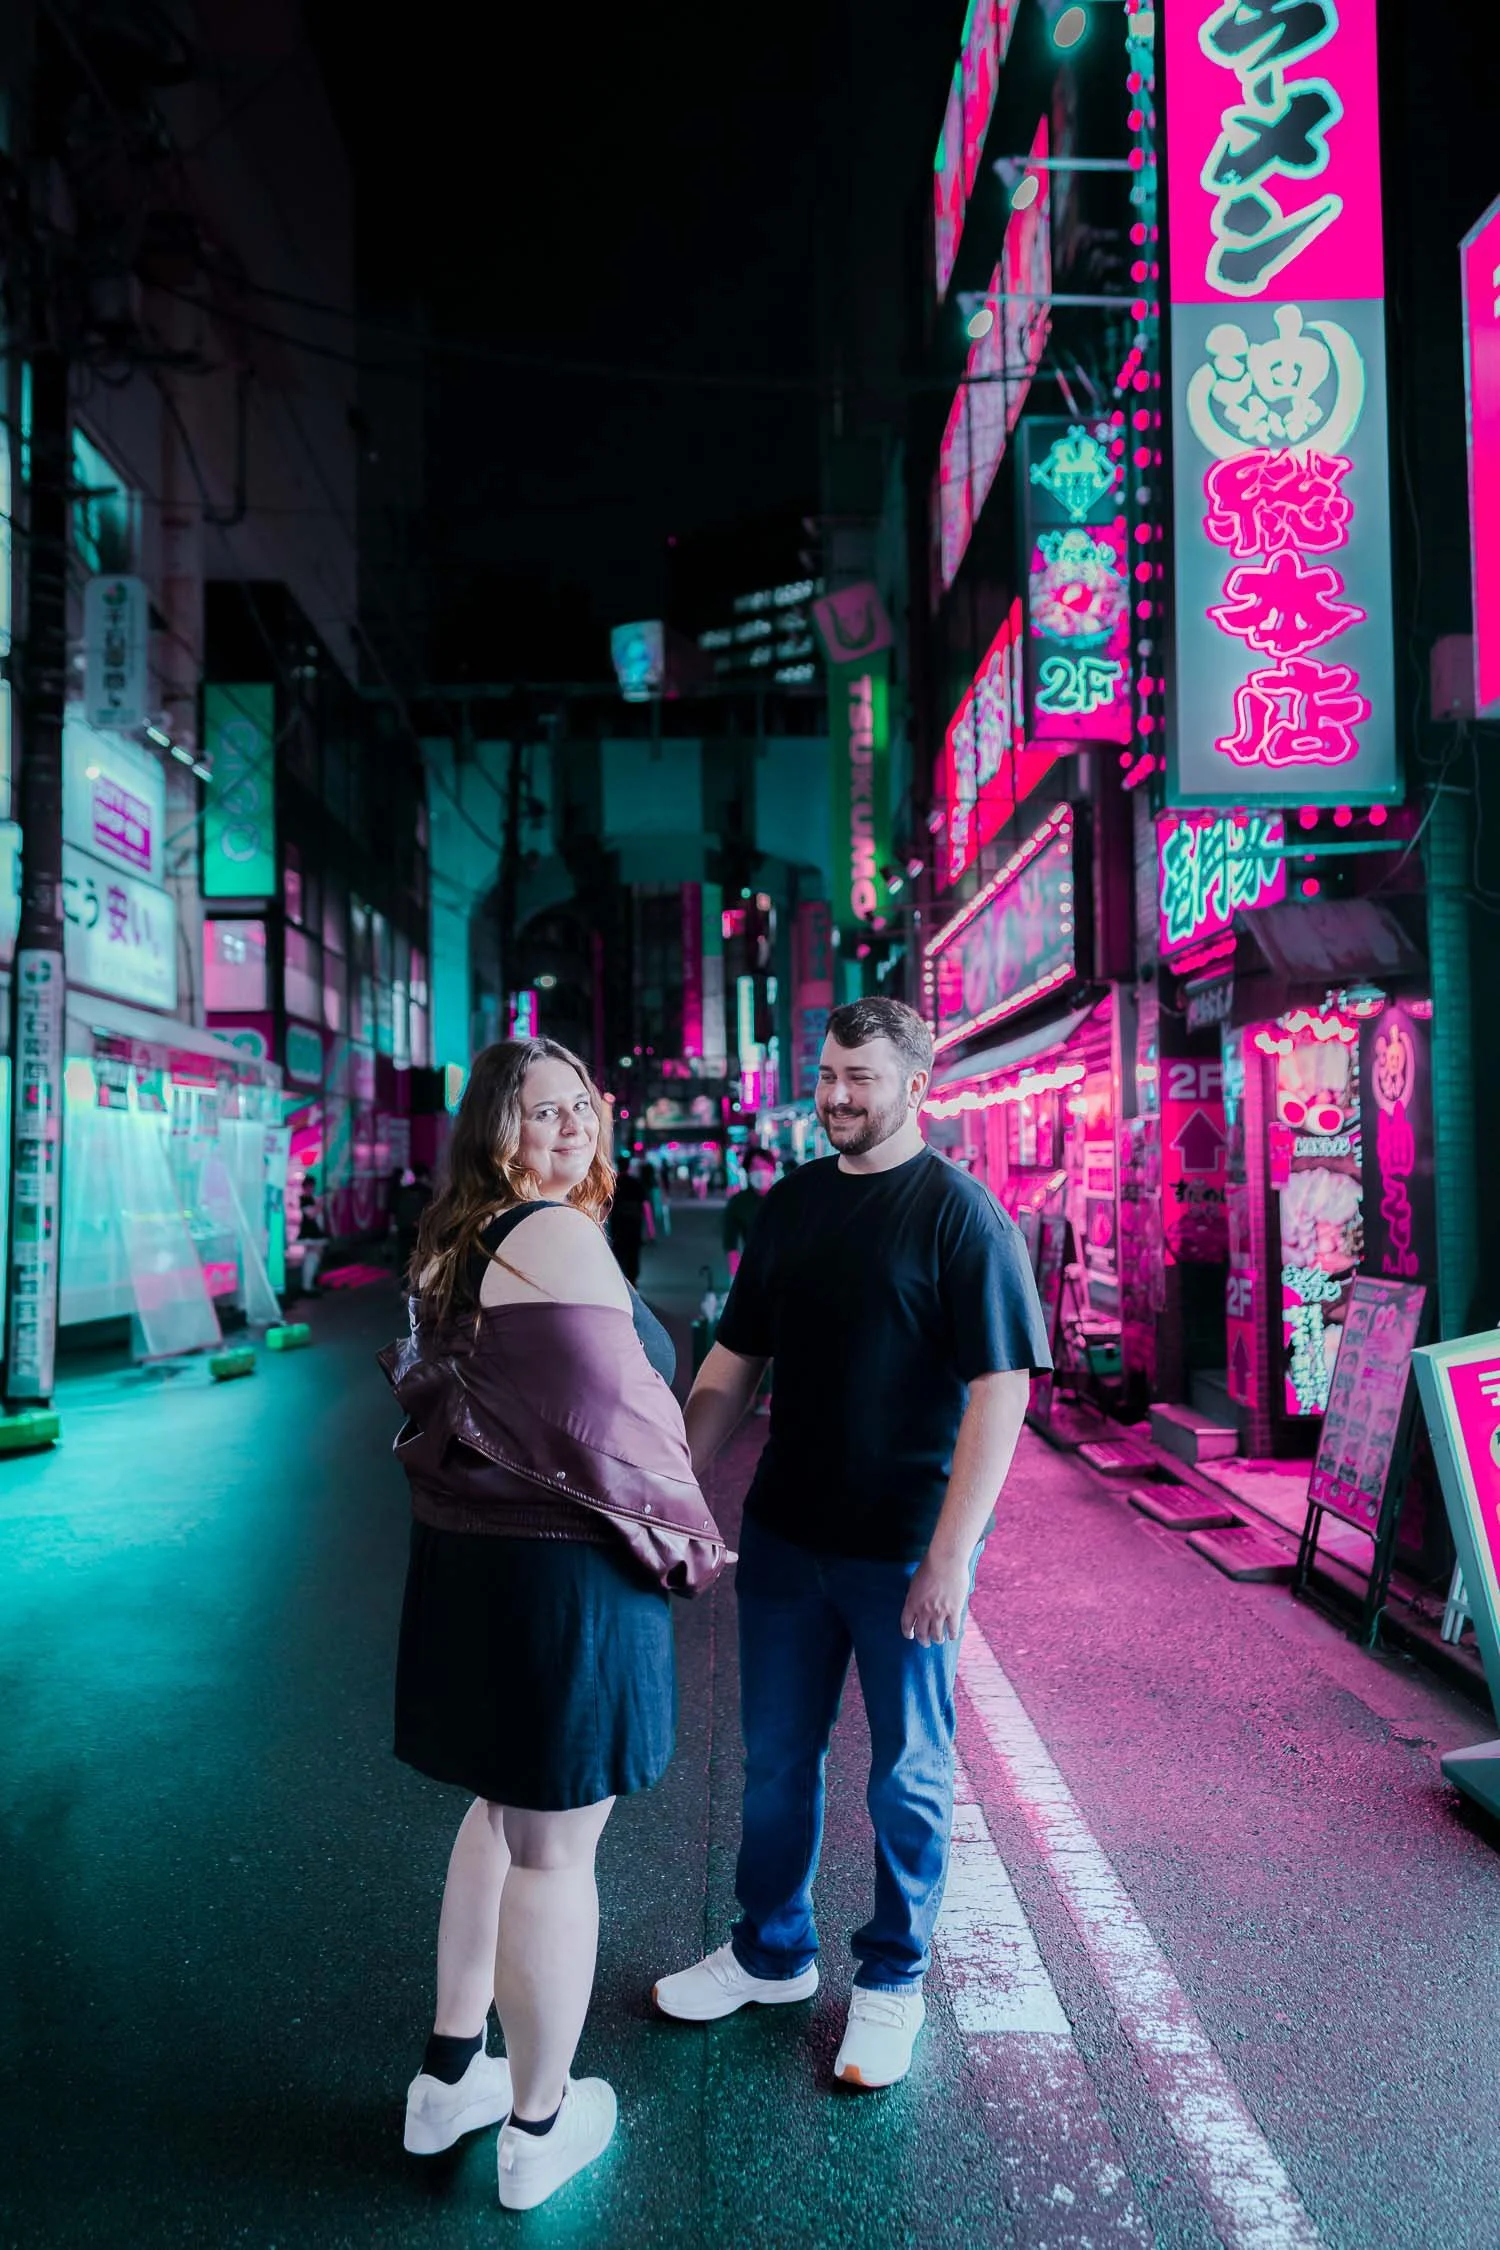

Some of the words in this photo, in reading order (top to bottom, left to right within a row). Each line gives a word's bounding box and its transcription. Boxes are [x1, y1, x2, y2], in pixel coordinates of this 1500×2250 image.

[1035, 655, 1122, 714] 2F
[848, 673, 878, 921] TSUKUMO
[1168, 1064, 1224, 1100] 2F
[1226, 1275, 1252, 1317] 2F
